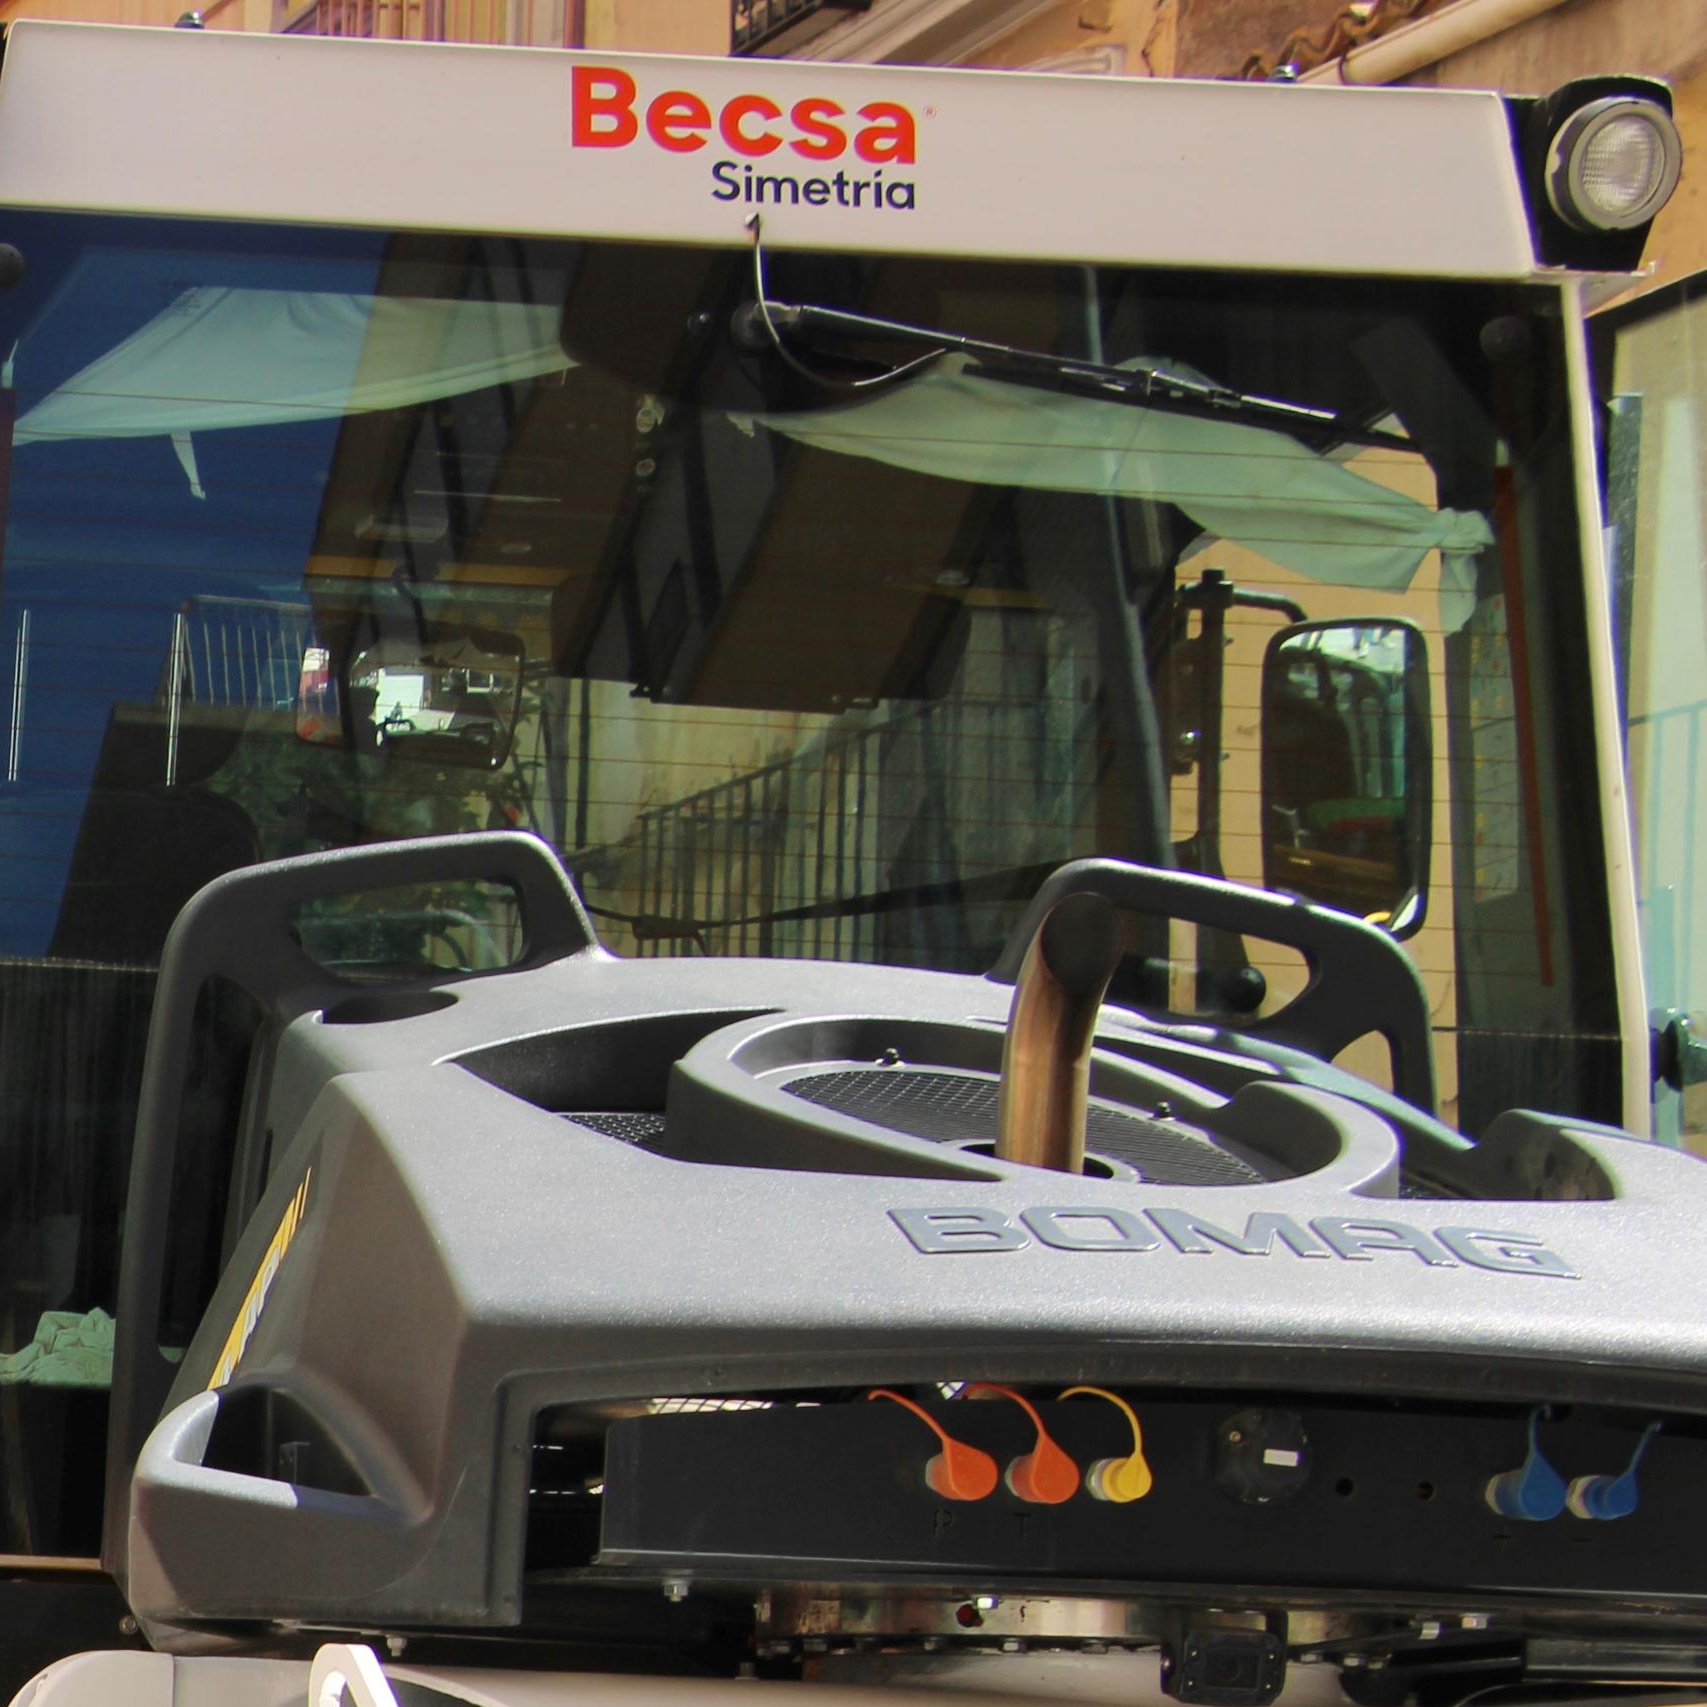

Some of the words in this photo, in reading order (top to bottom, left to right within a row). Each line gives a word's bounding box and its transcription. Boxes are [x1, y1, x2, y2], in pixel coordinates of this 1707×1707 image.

[571, 65, 916, 165] Becsa
[712, 161, 916, 210] Simetría
[887, 1205, 1583, 1280] BOMAG
